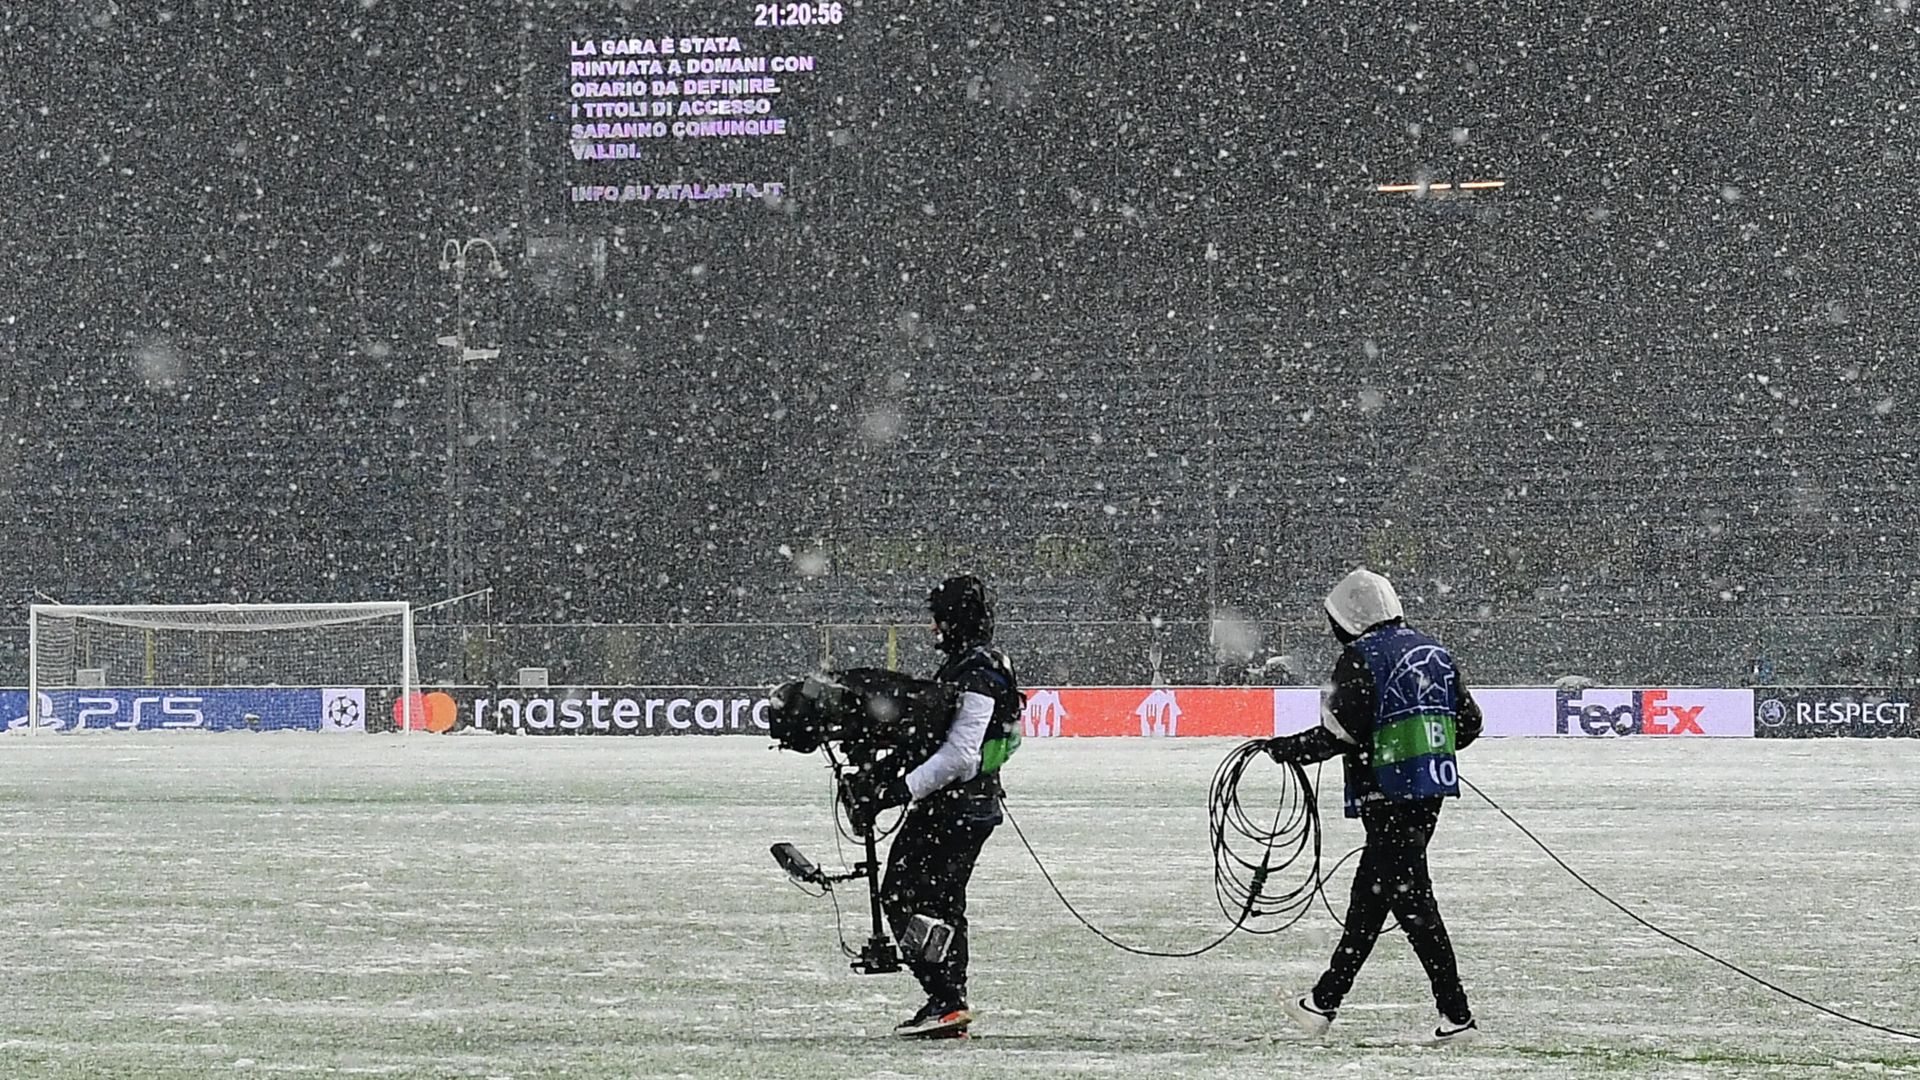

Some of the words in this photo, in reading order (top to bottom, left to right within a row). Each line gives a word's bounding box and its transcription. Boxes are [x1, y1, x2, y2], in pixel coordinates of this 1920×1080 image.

[755, 2, 843, 26] 21:20:56
[571, 41, 597, 56] LA
[602, 39, 657, 55] GARA
[661, 37, 675, 54] È
[680, 37, 741, 54] STATA
[571, 59, 663, 76] RINVIATA
[667, 59, 683, 74] A
[687, 57, 766, 74] DOMANI
[771, 56, 815, 72] CON
[571, 81, 648, 97] ORARIO
[653, 80, 679, 96] DA
[684, 78, 781, 95] DEFINIRE.
[571, 103, 578, 118] I
[582, 101, 648, 118] TITOLI
[653, 101, 673, 117] DI
[678, 99, 771, 117] ACCESSO
[571, 121, 667, 139] SARANNO
[672, 119, 787, 138] COMUNQUE
[571, 143, 642, 160] VALIDI.
[571, 185, 619, 201] INFO
[75, 697, 204, 728] PS5
[1555, 690, 1706, 736] FedEx
[1796, 702, 1910, 725] RESPECT
